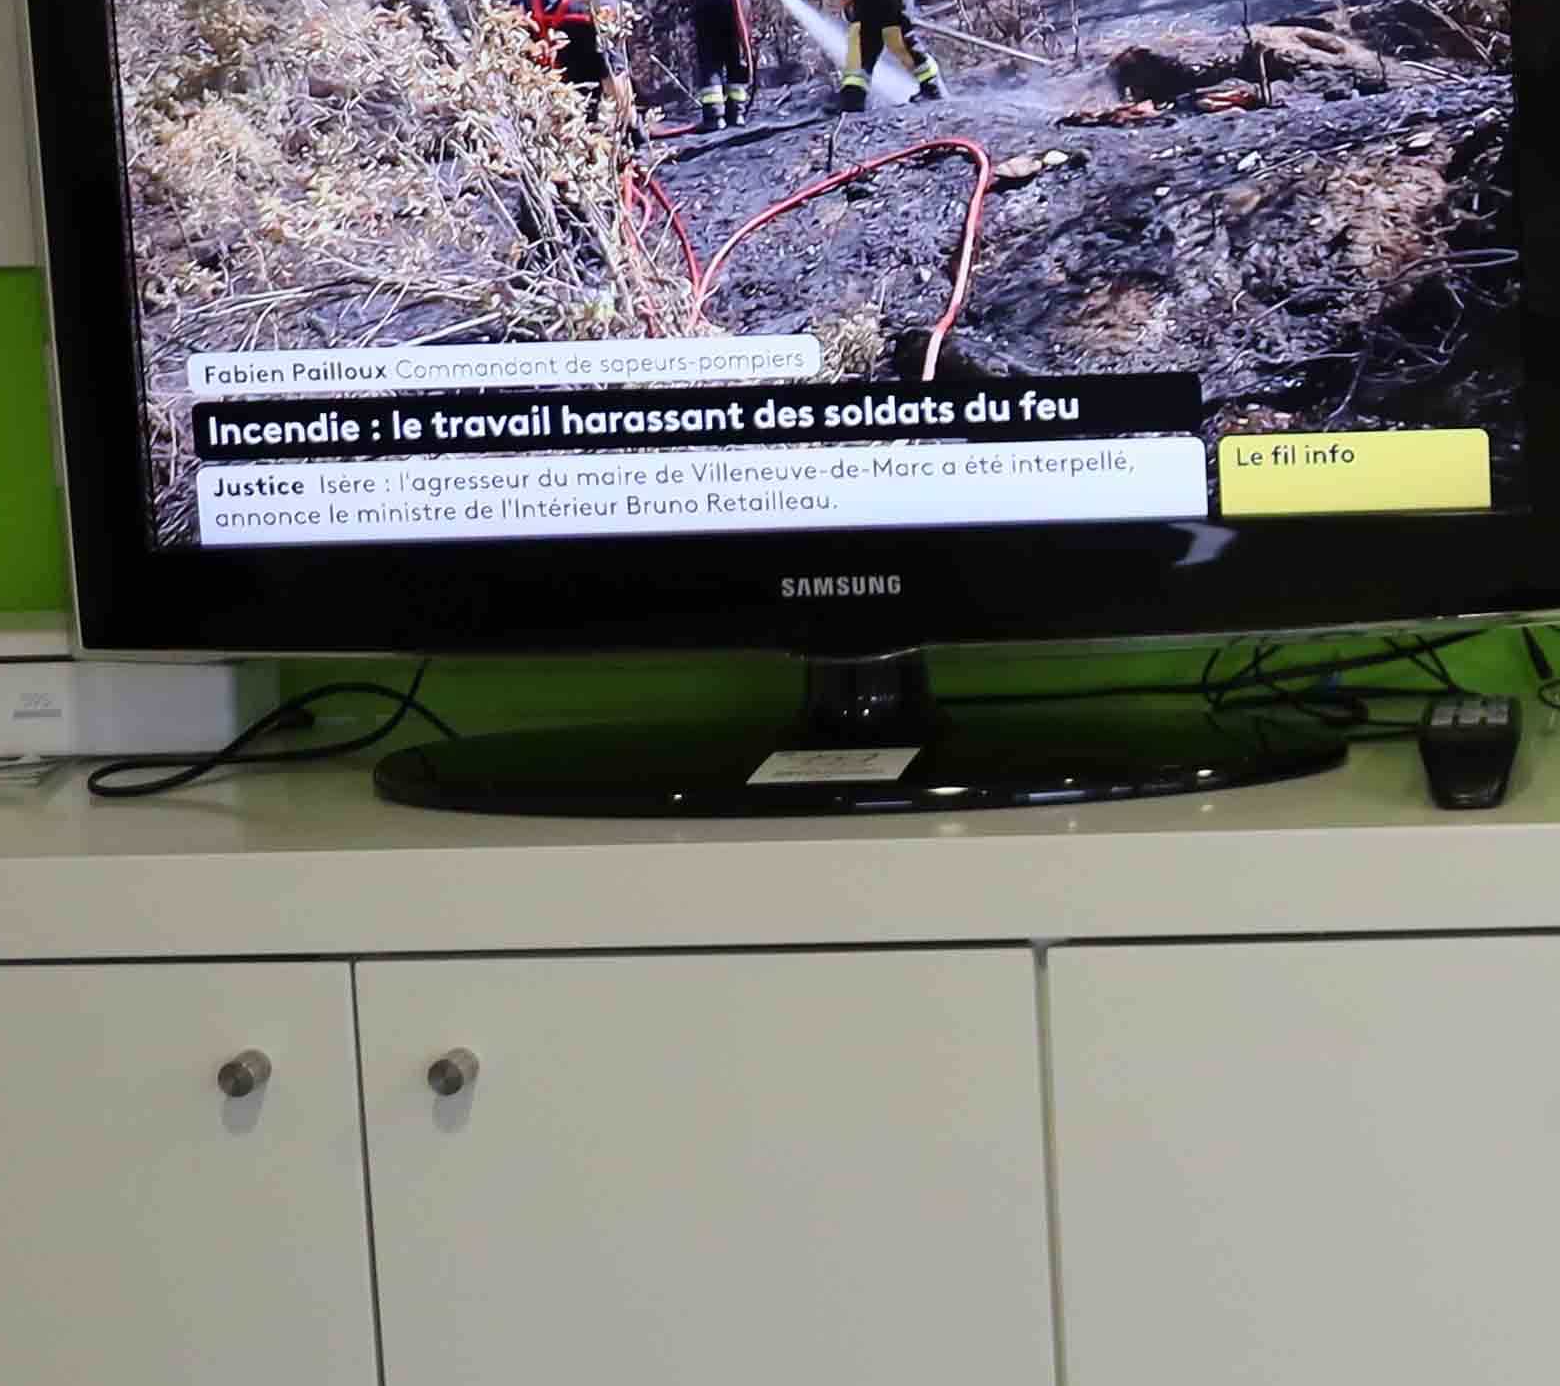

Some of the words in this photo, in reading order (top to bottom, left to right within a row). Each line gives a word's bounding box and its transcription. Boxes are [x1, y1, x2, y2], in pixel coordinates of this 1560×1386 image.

[204, 363, 286, 386] Fabien
[292, 360, 387, 383] Pailloux
[395, 354, 558, 381] Commandant
[564, 354, 592, 376] de
[599, 348, 804, 379] sapeurs-pompiers
[208, 410, 361, 447] Incendie
[370, 417, 382, 441] :
[392, 410, 423, 441] le
[432, 404, 551, 439] travail
[562, 400, 744, 436] harassant
[753, 398, 816, 429] des
[824, 392, 954, 428] soldats
[965, 392, 1011, 424] du
[1018, 389, 1080, 422] feu
[1237, 448, 1263, 466] Le
[1270, 444, 1297, 465] fil
[1304, 443, 1354, 465] info
[213, 475, 305, 499] Justice
[319, 471, 376, 496] Isère
[383, 476, 391, 494] :
[400, 468, 530, 497] l'agresseur
[537, 467, 568, 489] du
[575, 465, 647, 488] maire
[653, 463, 684, 485] de
[691, 456, 934, 484] Villeneuve-de-Marc
[941, 460, 956, 479] a
[965, 454, 1004, 476] été
[1011, 450, 1136, 479] interpellé,
[215, 505, 322, 528] annonce
[328, 502, 349, 525] le
[357, 500, 457, 524] ministre
[463, 499, 494, 520] de
[501, 494, 617, 520] l'Intérieur
[626, 494, 699, 516] Bruno
[707, 490, 839, 514] Retailleau.
[781, 574, 902, 597] SAMSUNG
